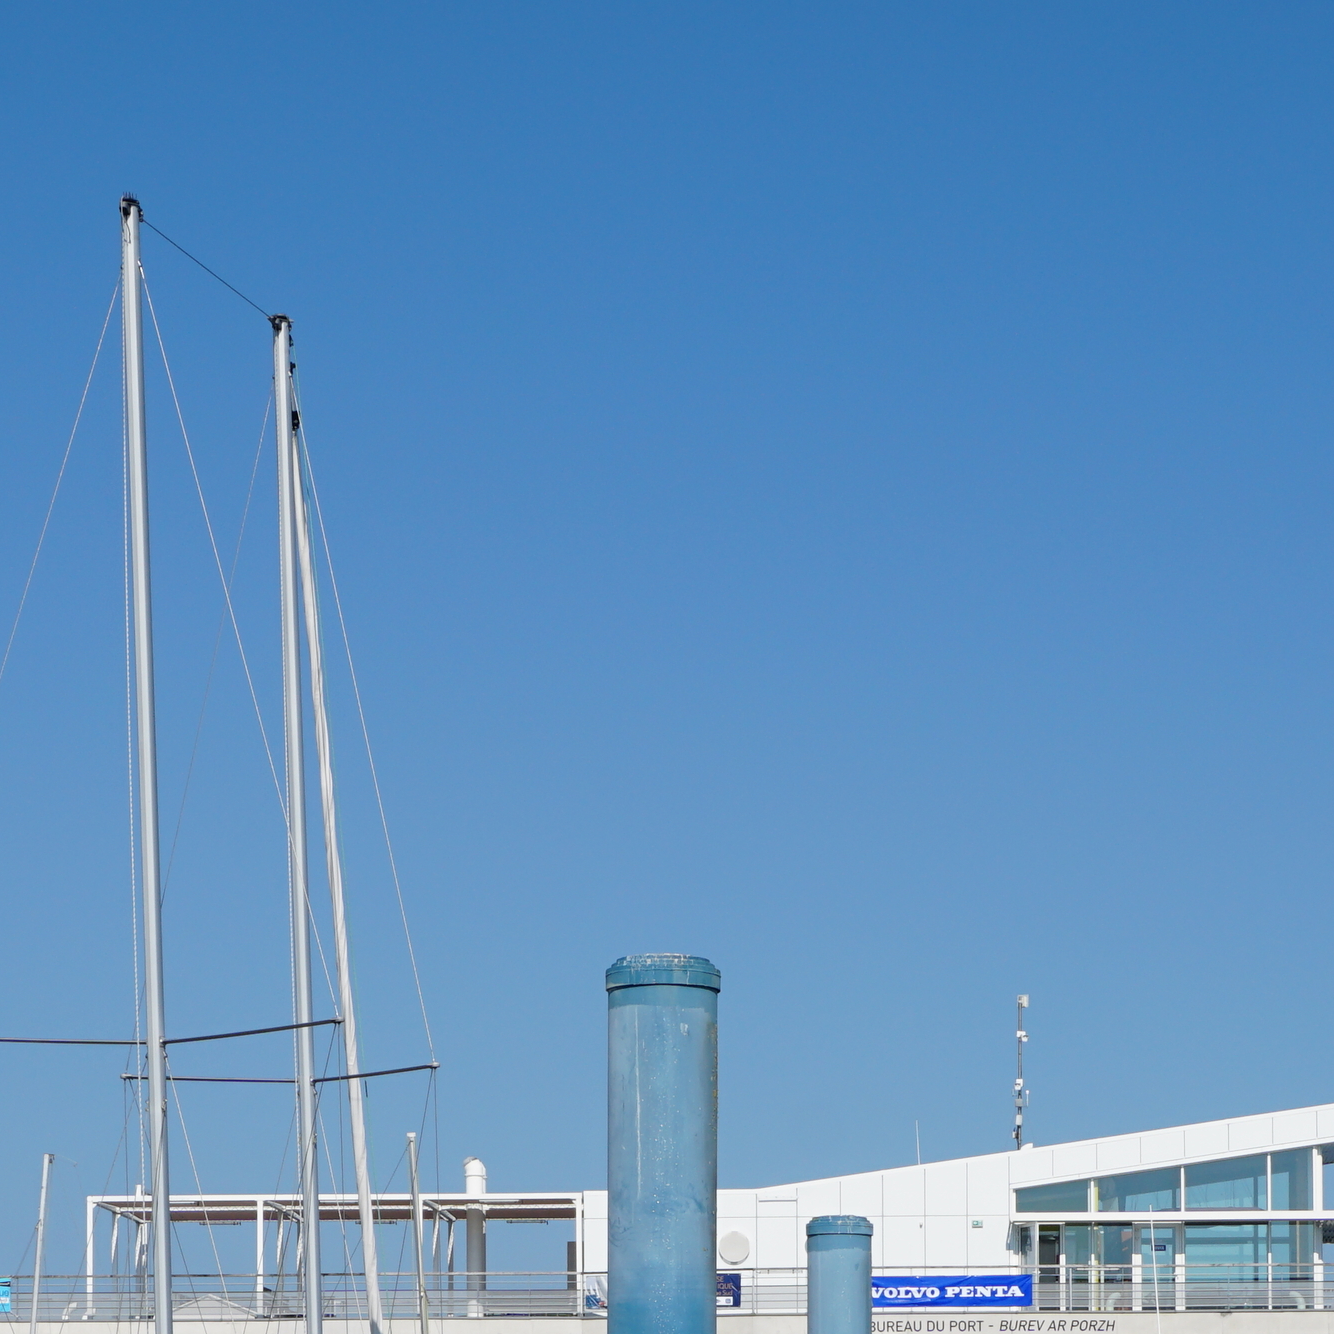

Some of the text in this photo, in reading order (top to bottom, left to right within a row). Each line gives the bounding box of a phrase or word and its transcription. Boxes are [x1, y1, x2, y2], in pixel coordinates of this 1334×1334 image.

[872, 1286, 1025, 1299] VOLVO PENTA
[871, 1320, 922, 1332] BUREAU
[927, 1320, 945, 1332] DU
[949, 1320, 984, 1332] PORT
[999, 1319, 1045, 1332] BUREV
[1047, 1319, 1067, 1332] AR
[1070, 1319, 1115, 1332] PORZH
